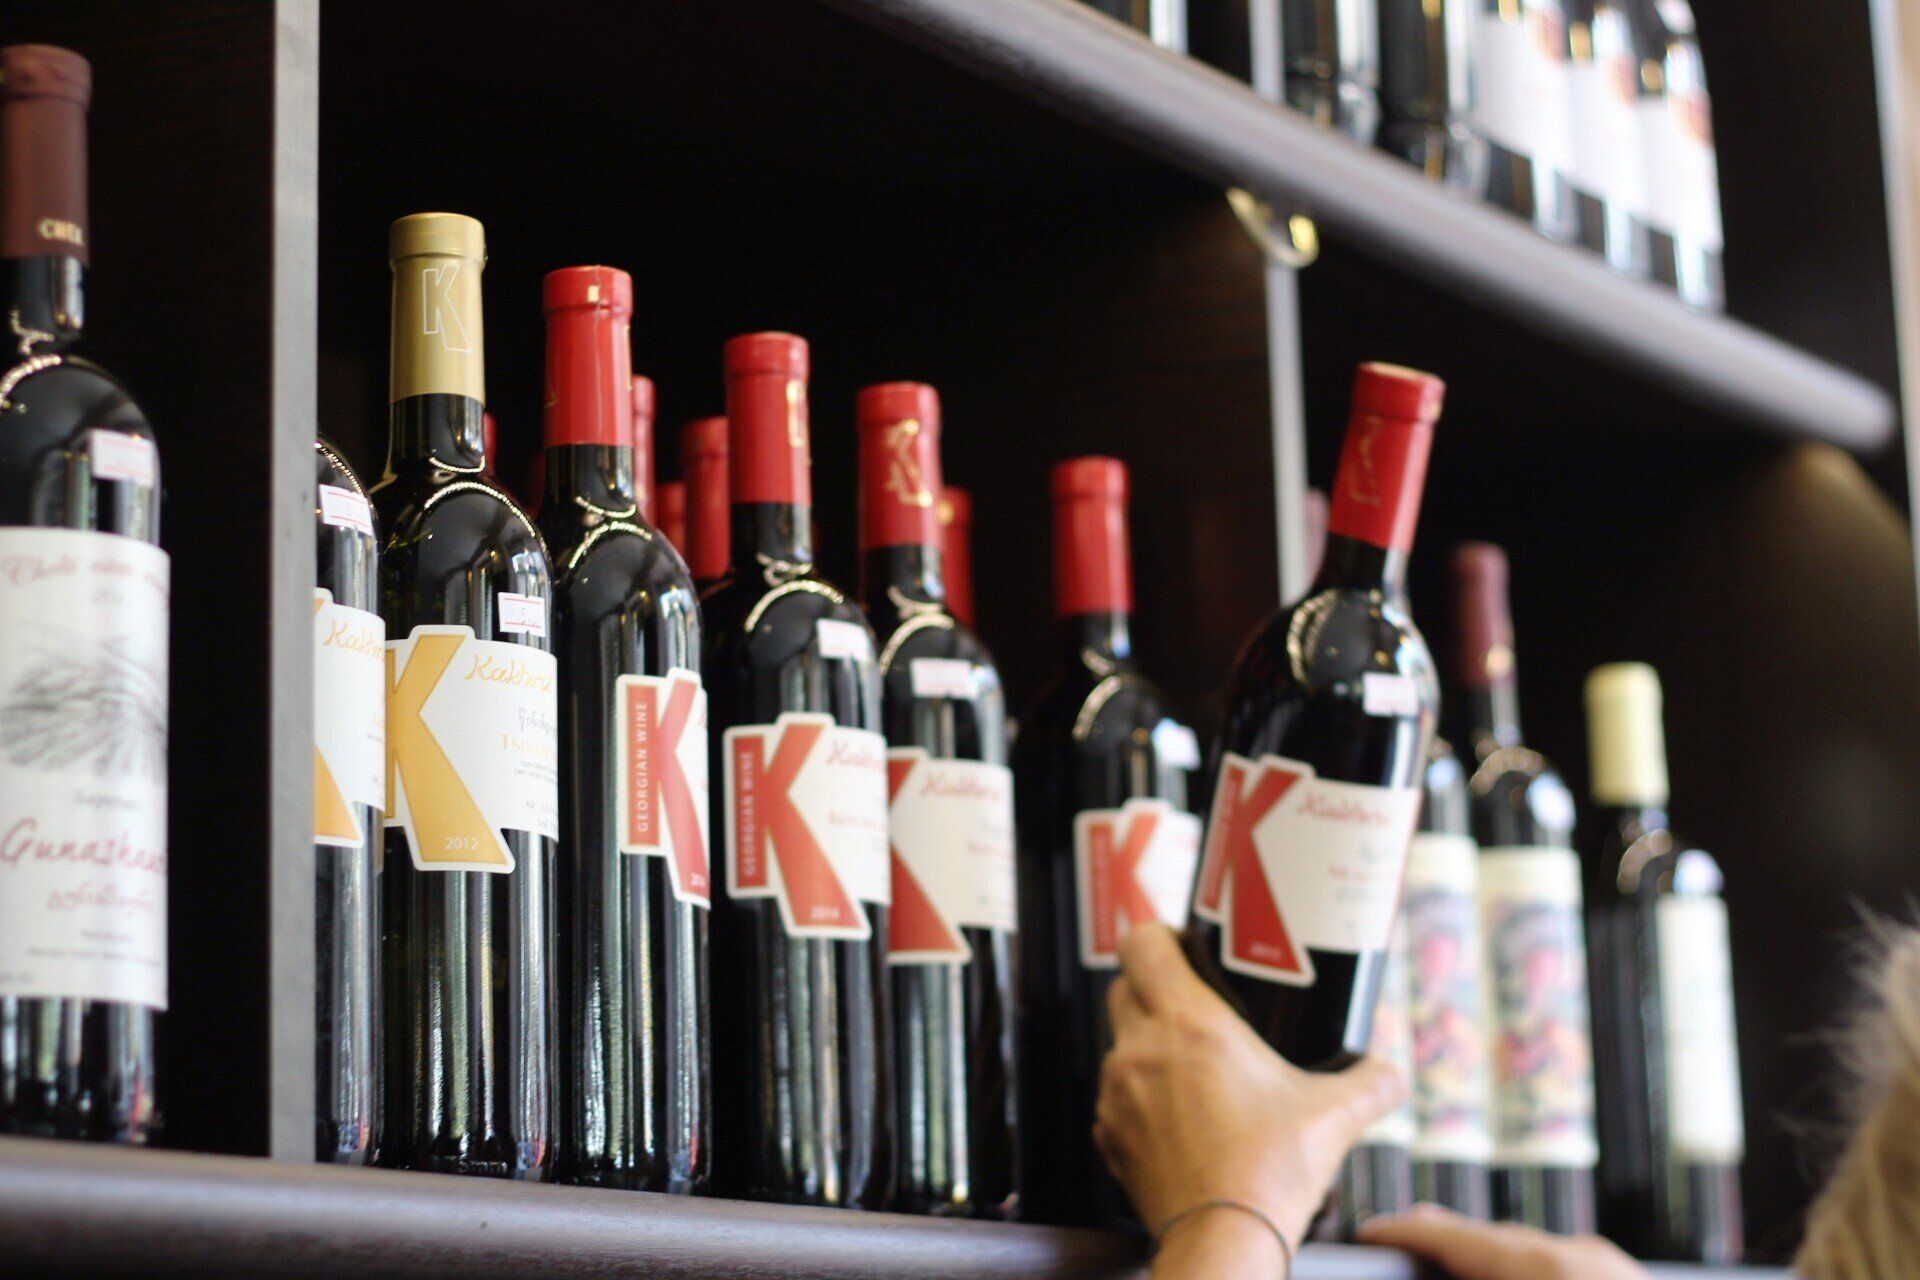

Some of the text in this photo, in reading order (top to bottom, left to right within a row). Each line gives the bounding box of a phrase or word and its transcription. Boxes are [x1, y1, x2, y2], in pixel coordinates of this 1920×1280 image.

[422, 263, 472, 353] K
[446, 837, 478, 850] 2012
[626, 677, 710, 898] K
[635, 701, 649, 832] GEORGIAN WINE
[733, 723, 864, 928] K
[1204, 765, 1303, 974] K
